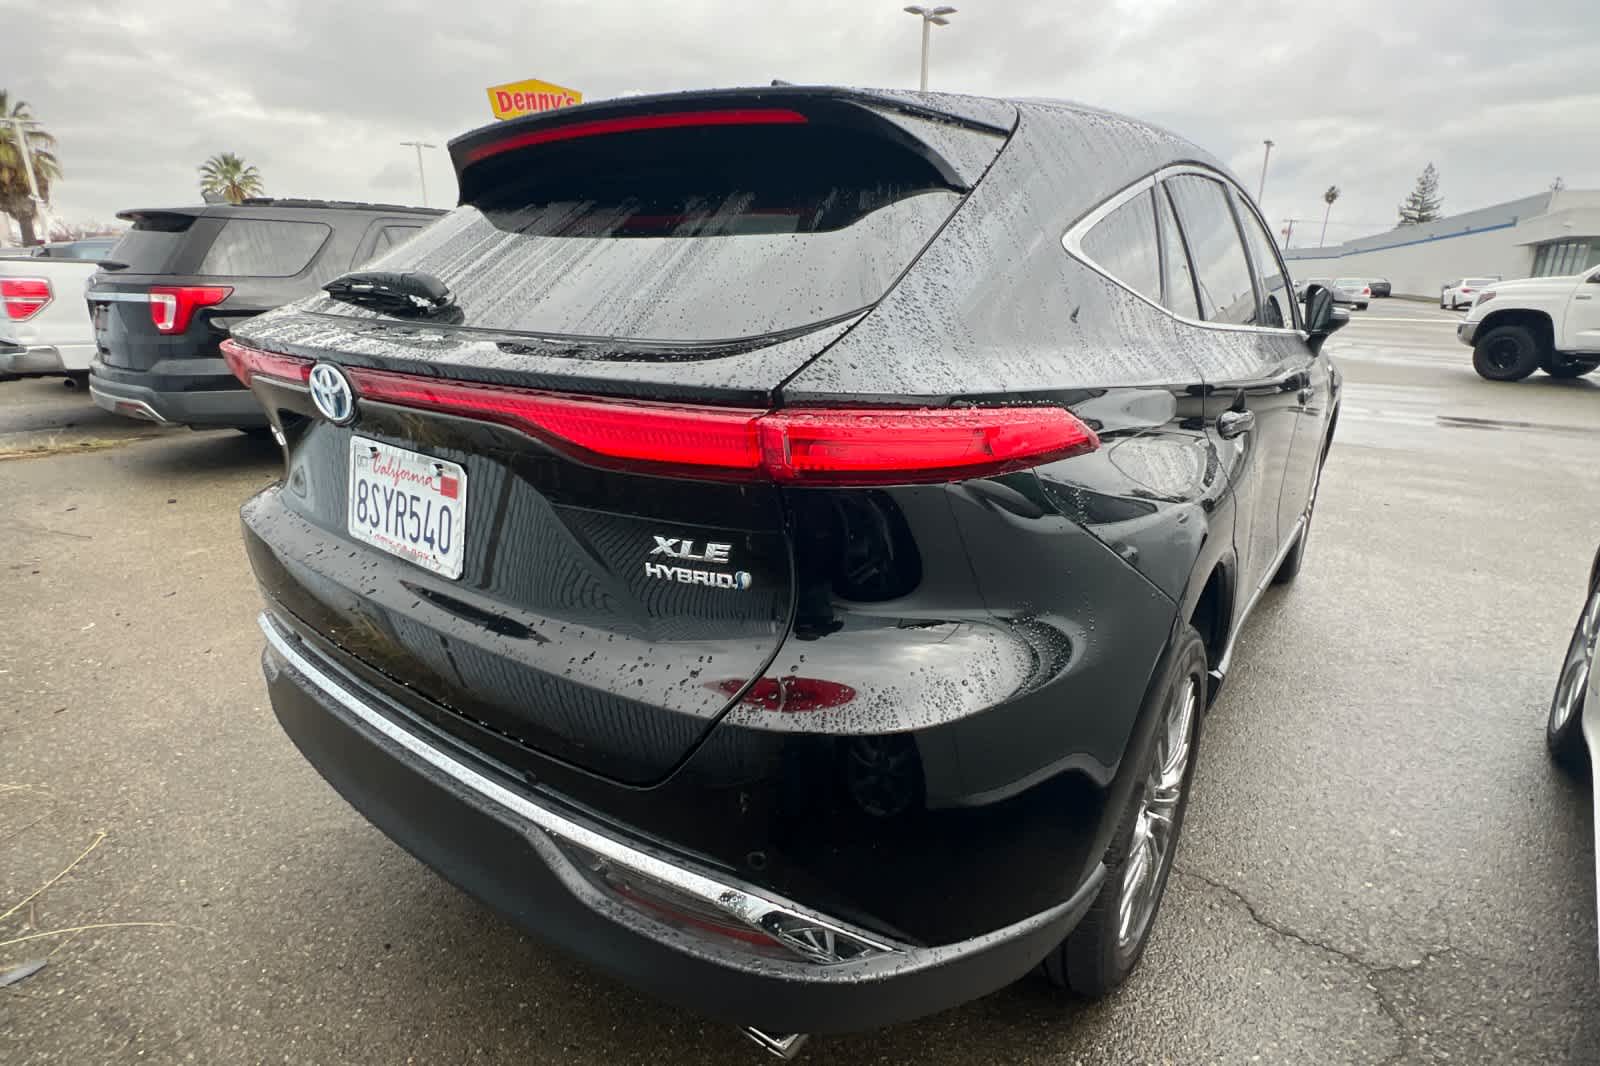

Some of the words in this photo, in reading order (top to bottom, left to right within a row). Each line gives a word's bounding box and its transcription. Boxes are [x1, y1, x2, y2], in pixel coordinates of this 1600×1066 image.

[371, 452, 440, 491] California
[357, 478, 452, 554] 8SYR540
[649, 535, 732, 563] XLE
[645, 562, 734, 589] HYBRID
